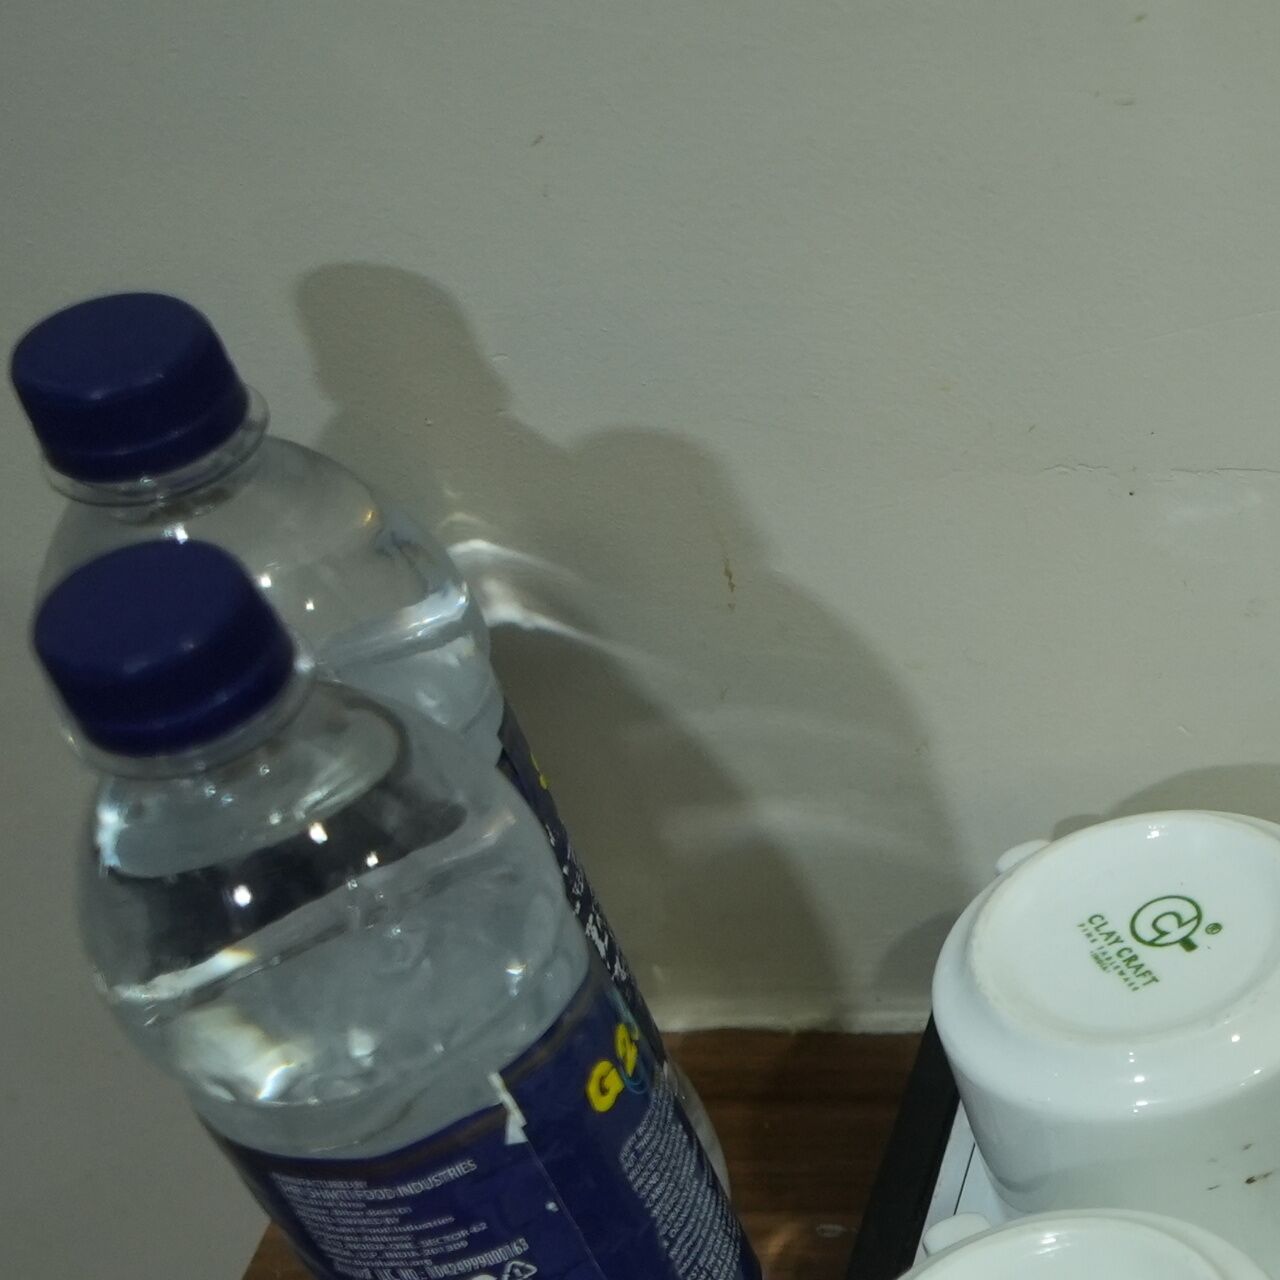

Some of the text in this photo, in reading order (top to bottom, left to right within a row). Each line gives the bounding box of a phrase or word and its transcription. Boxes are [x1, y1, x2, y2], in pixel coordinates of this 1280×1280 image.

[1088, 914, 1159, 986] CLAY CRAFT
[396, 1159, 478, 1198] INDUSTRIES
